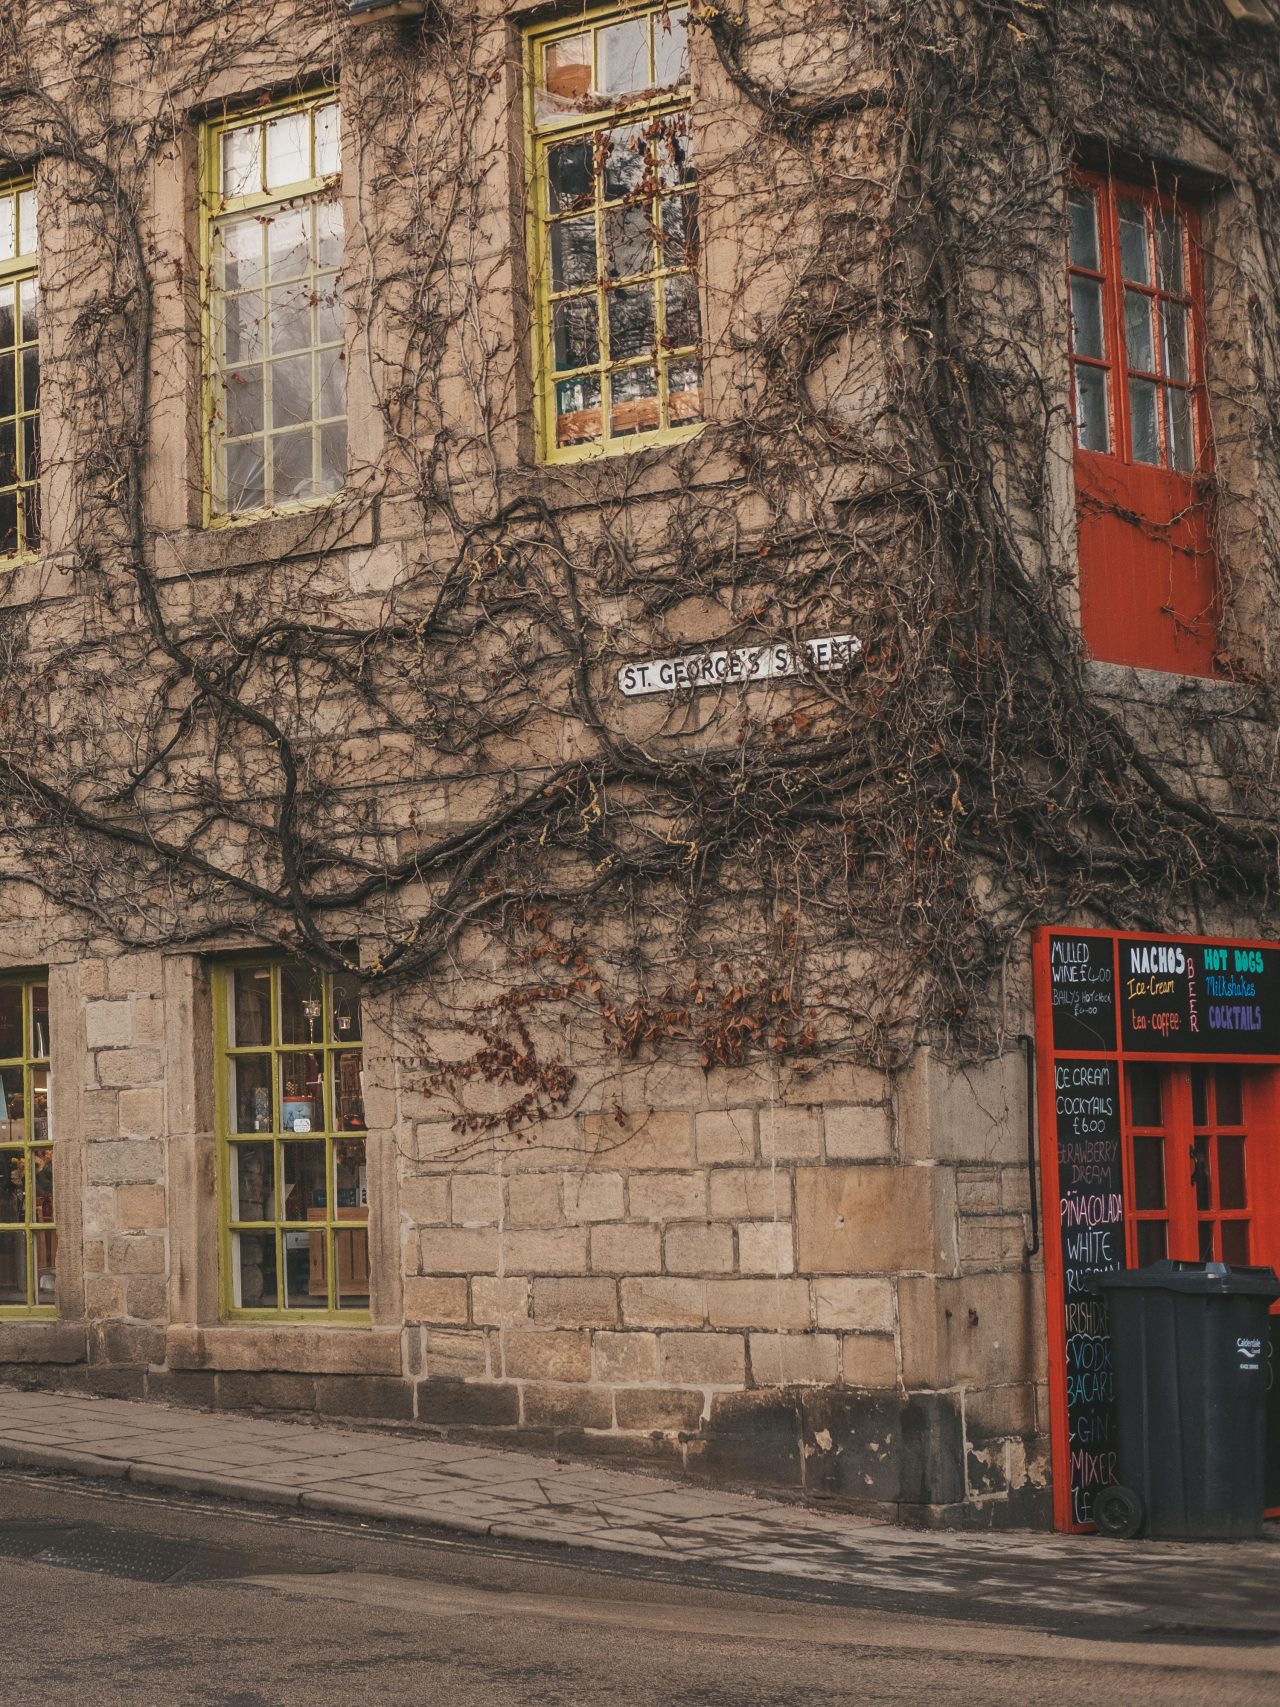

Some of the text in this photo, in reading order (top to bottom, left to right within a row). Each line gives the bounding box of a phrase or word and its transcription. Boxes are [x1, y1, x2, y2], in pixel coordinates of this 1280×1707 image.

[624, 666, 651, 689] ST.
[660, 651, 760, 684] GEORGE'S
[1052, 941, 1089, 963] MULLED
[1130, 946, 1185, 974] NACHOS
[1204, 948, 1264, 973] HOT DOGS
[1052, 966, 1078, 982] WINE
[1187, 958, 1199, 1032] BEER
[1208, 1006, 1261, 1031] COCKTAILS
[1054, 1065, 1110, 1090] ICE CREAM
[1056, 1096, 1113, 1116] COCKTAILS
[1071, 1165, 1112, 1188] DREAM
[1067, 1226, 1112, 1264] WHITE
[1072, 1341, 1113, 1372] VODK
